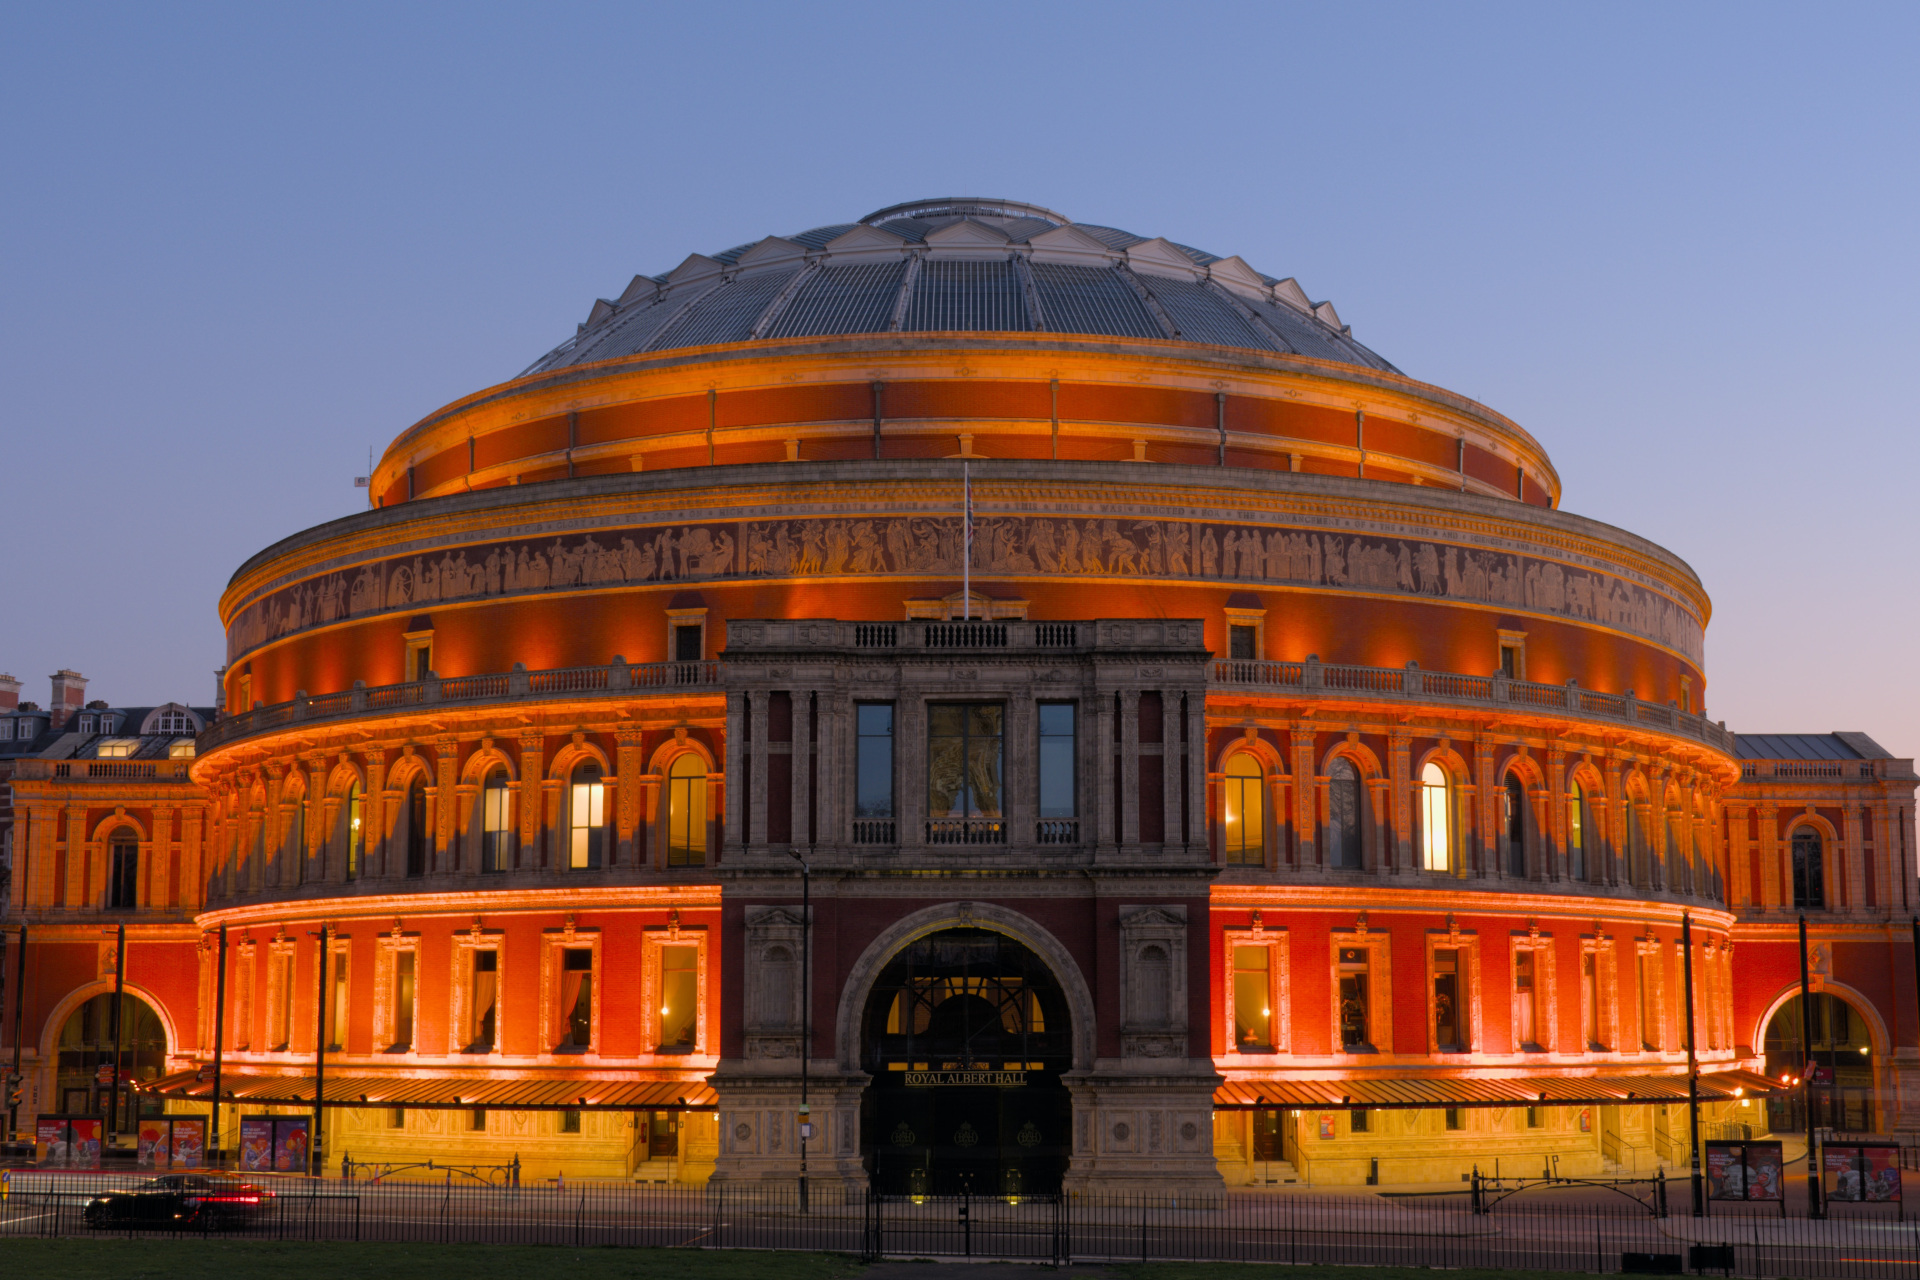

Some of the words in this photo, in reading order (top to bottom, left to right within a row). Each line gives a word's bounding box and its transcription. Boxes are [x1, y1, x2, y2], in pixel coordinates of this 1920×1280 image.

[557, 519, 586, 529] GLORY
[1055, 503, 1083, 512] HALL
[1099, 504, 1123, 512] WAS
[1140, 504, 1185, 515] ERECTED
[1201, 508, 1221, 517] FOR
[1237, 511, 1256, 520] THE
[1271, 513, 1341, 526] ADVANCEMENT
[1354, 520, 1366, 529] OF
[1408, 527, 1430, 536] ARTS
[905, 1073, 945, 1084] ROYAL
[947, 1073, 993, 1084] ALBERT
[995, 1073, 1027, 1084] HALL
